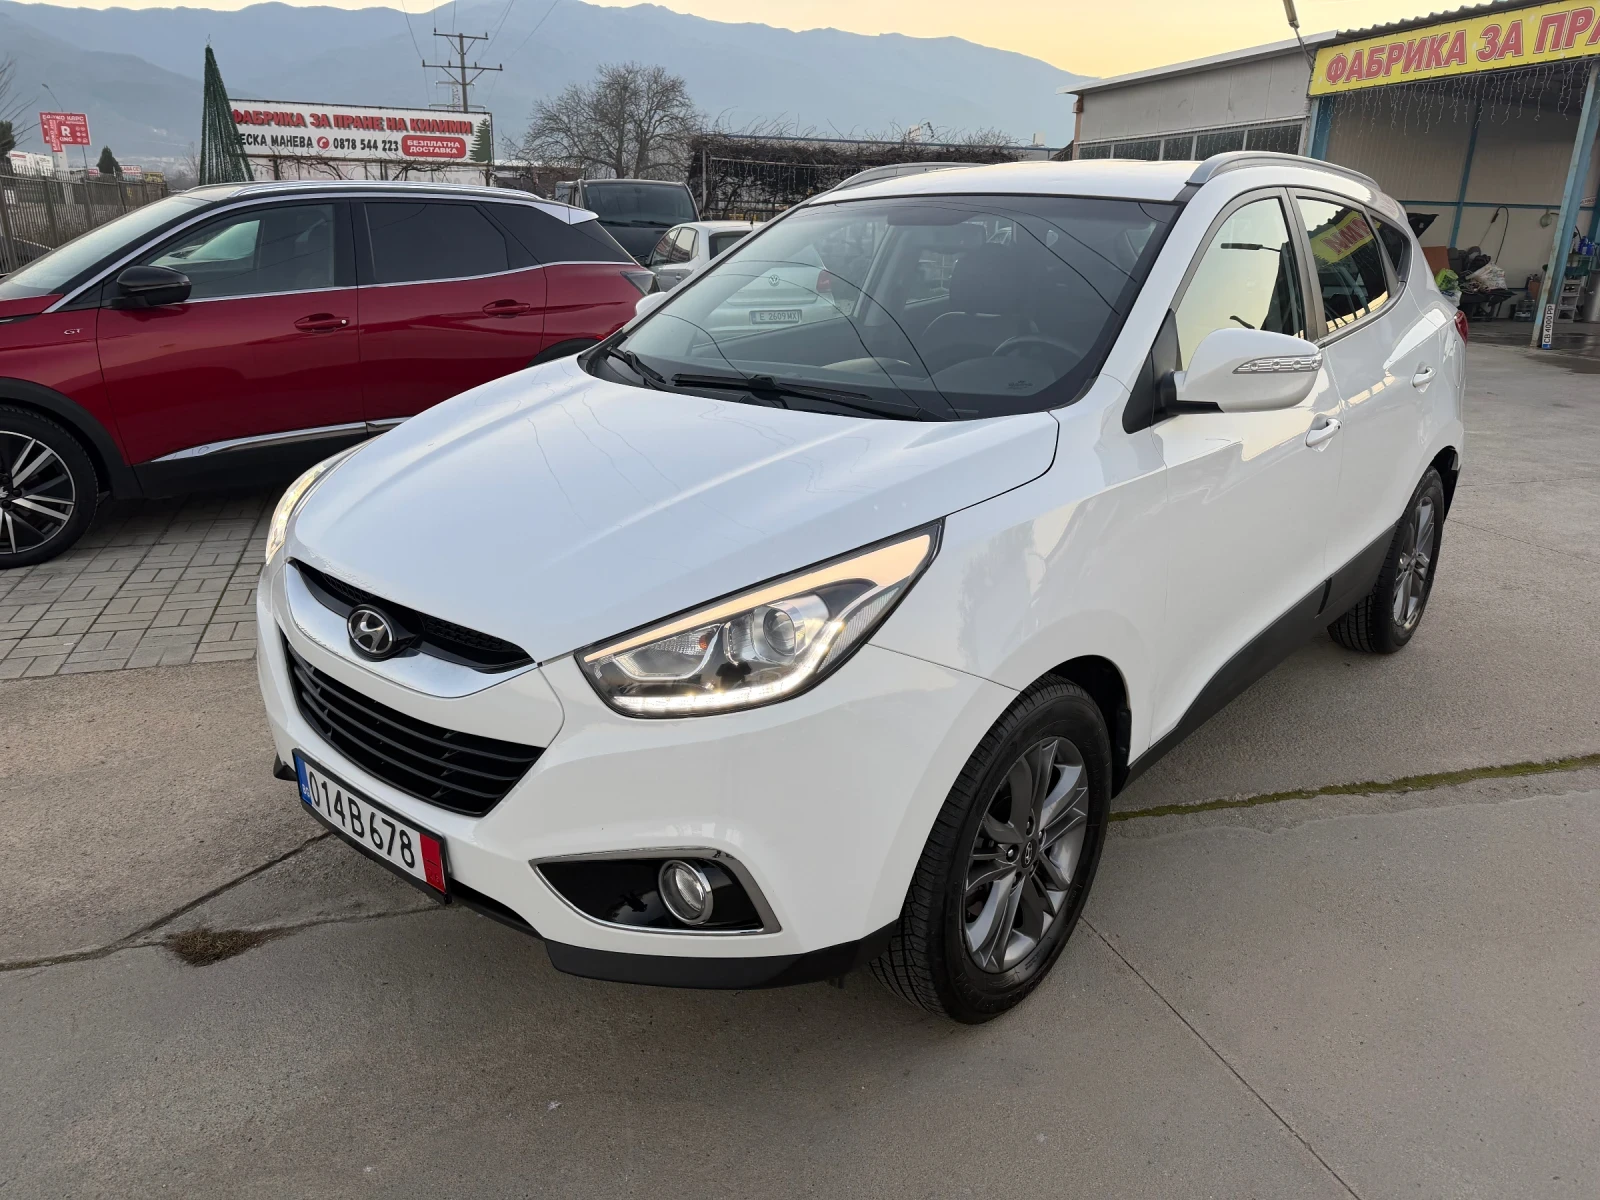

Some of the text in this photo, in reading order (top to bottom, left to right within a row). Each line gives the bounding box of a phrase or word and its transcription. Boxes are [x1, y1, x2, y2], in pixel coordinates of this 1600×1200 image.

[1325, 29, 1467, 85] ФАБРИКА
[1475, 19, 1523, 63] ЗА
[232, 109, 473, 135] ФАБРИКА ЗА ПРАНЕ НА КИЛИМИ
[270, 135, 314, 149] МАНЕВА
[333, 137, 399, 152] 0878 544 223
[407, 140, 460, 148] БЕЗПЛАТНА
[410, 146, 458, 154] ДОСТАВКА
[1546, 306, 1553, 314] PP
[1544, 334, 1550, 344] CB
